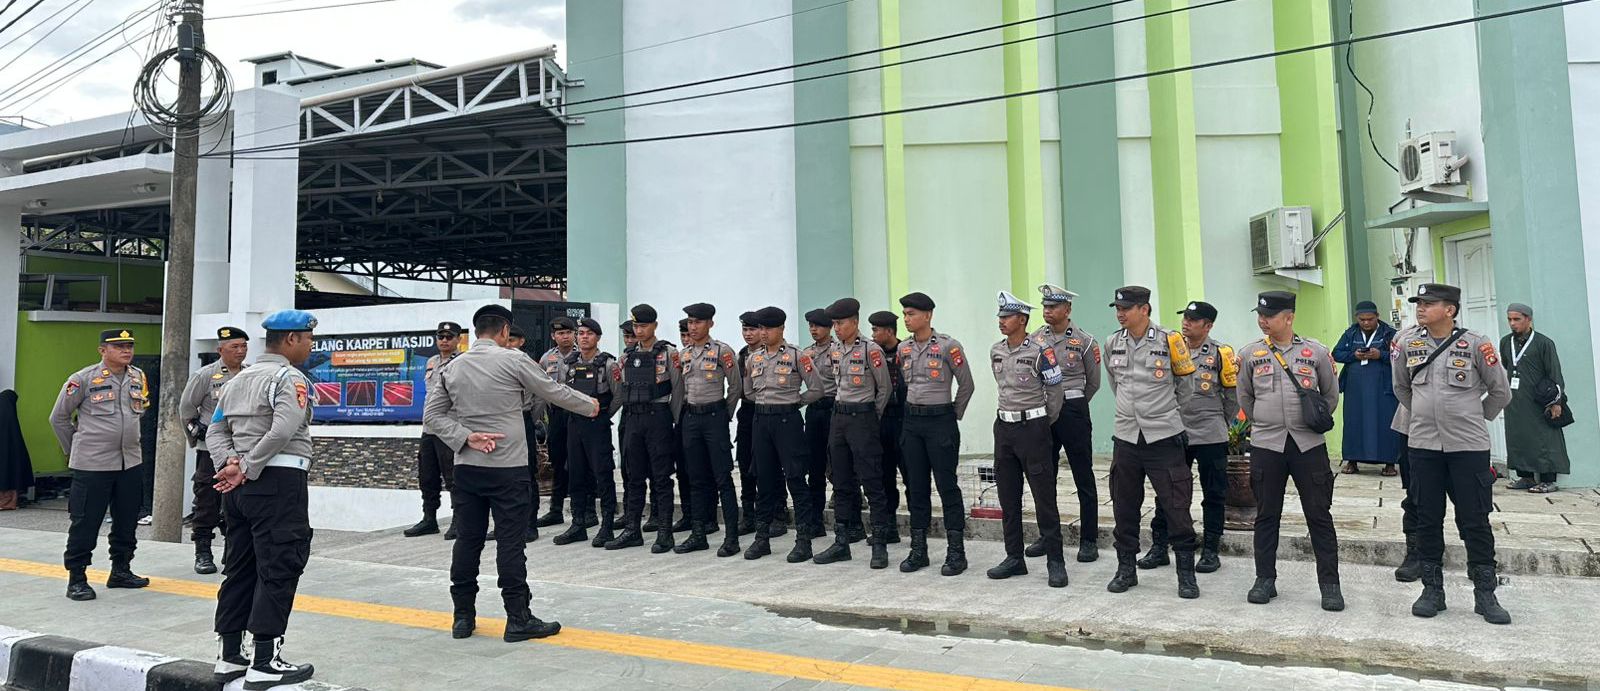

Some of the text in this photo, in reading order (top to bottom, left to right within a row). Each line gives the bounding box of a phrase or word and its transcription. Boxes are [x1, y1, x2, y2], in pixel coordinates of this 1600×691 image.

[311, 335, 434, 352] ELANG KARPET MASJID
[1449, 350, 1472, 358] POLRI
[1295, 358, 1316, 367] POLRI
